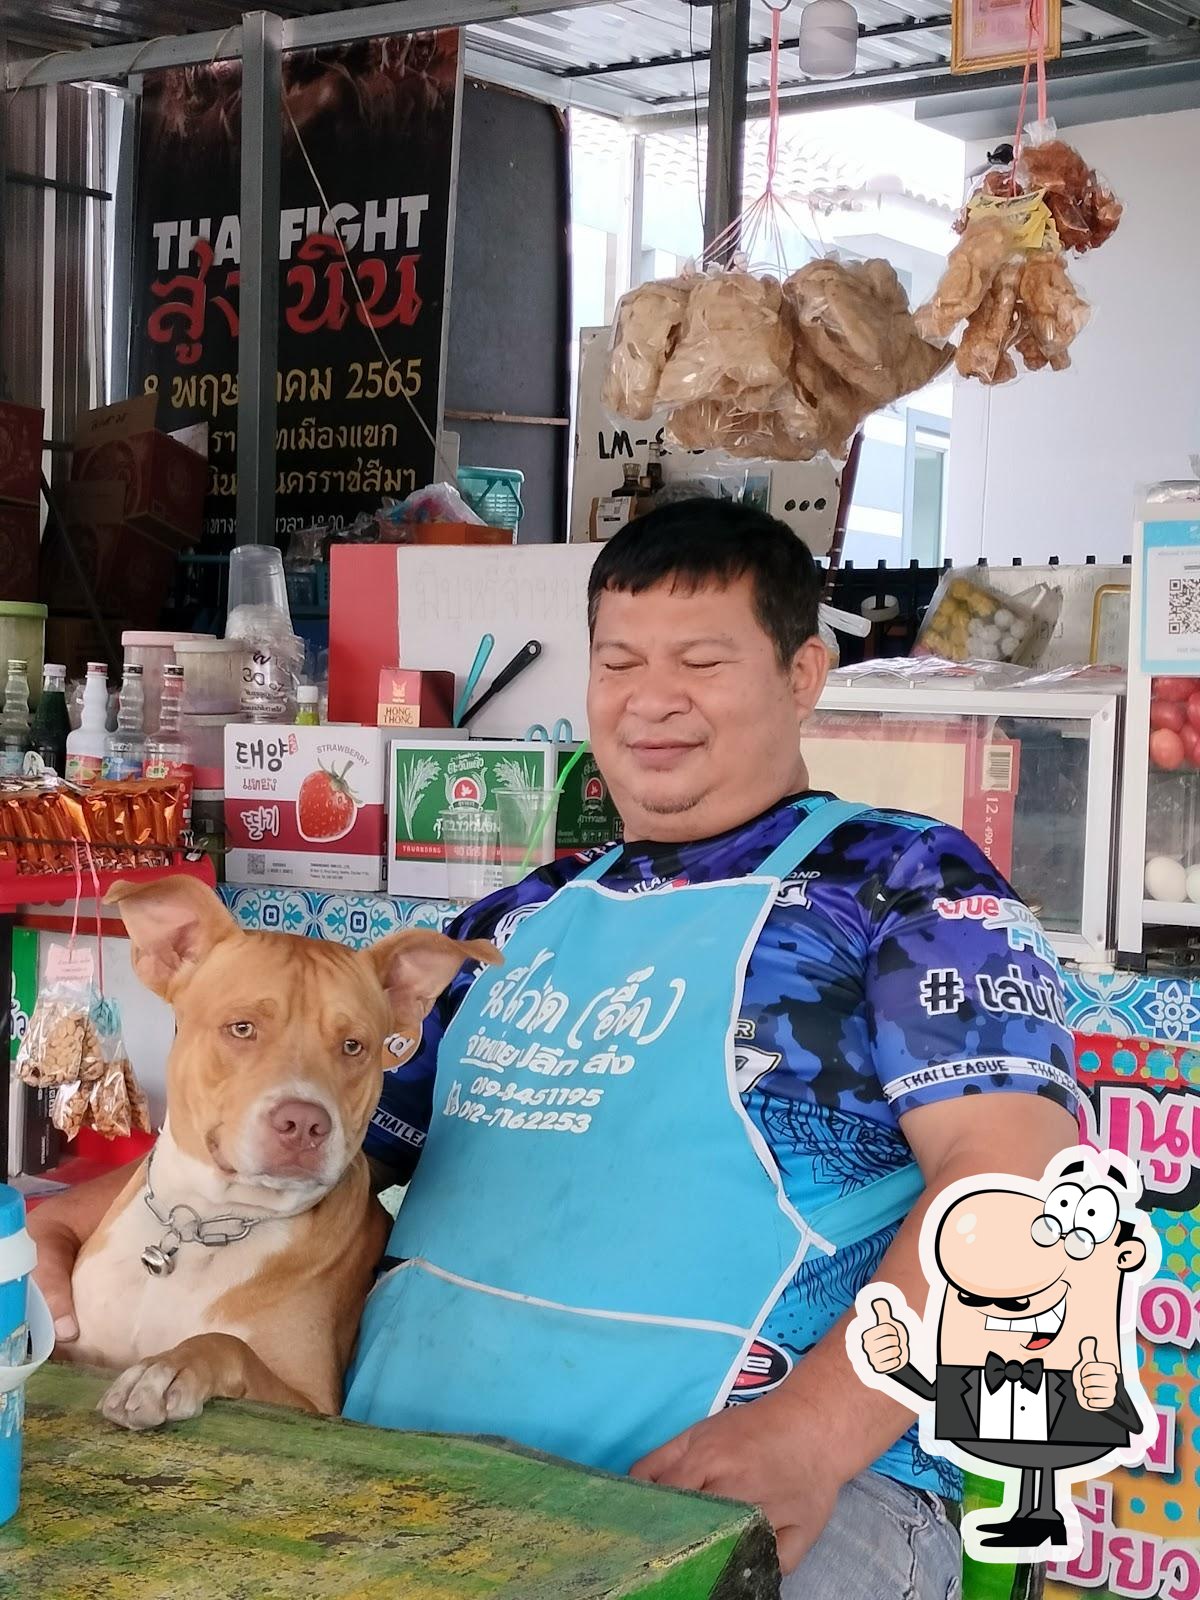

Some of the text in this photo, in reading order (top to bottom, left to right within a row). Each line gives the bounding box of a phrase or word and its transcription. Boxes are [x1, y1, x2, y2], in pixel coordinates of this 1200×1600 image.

[153, 194, 429, 271] THA FIGHT
[345, 358, 423, 400] 2565
[383, 714, 414, 724] THONG
[385, 706, 411, 716] HONG
[235, 738, 289, 773] 태양
[316, 743, 370, 767] STRAWBERRY
[985, 797, 999, 814] 12
[937, 897, 1000, 917] true
[901, 1067, 938, 1090] THAI
[942, 1059, 1011, 1079] LEAGUE
[371, 1108, 402, 1136] THAI
